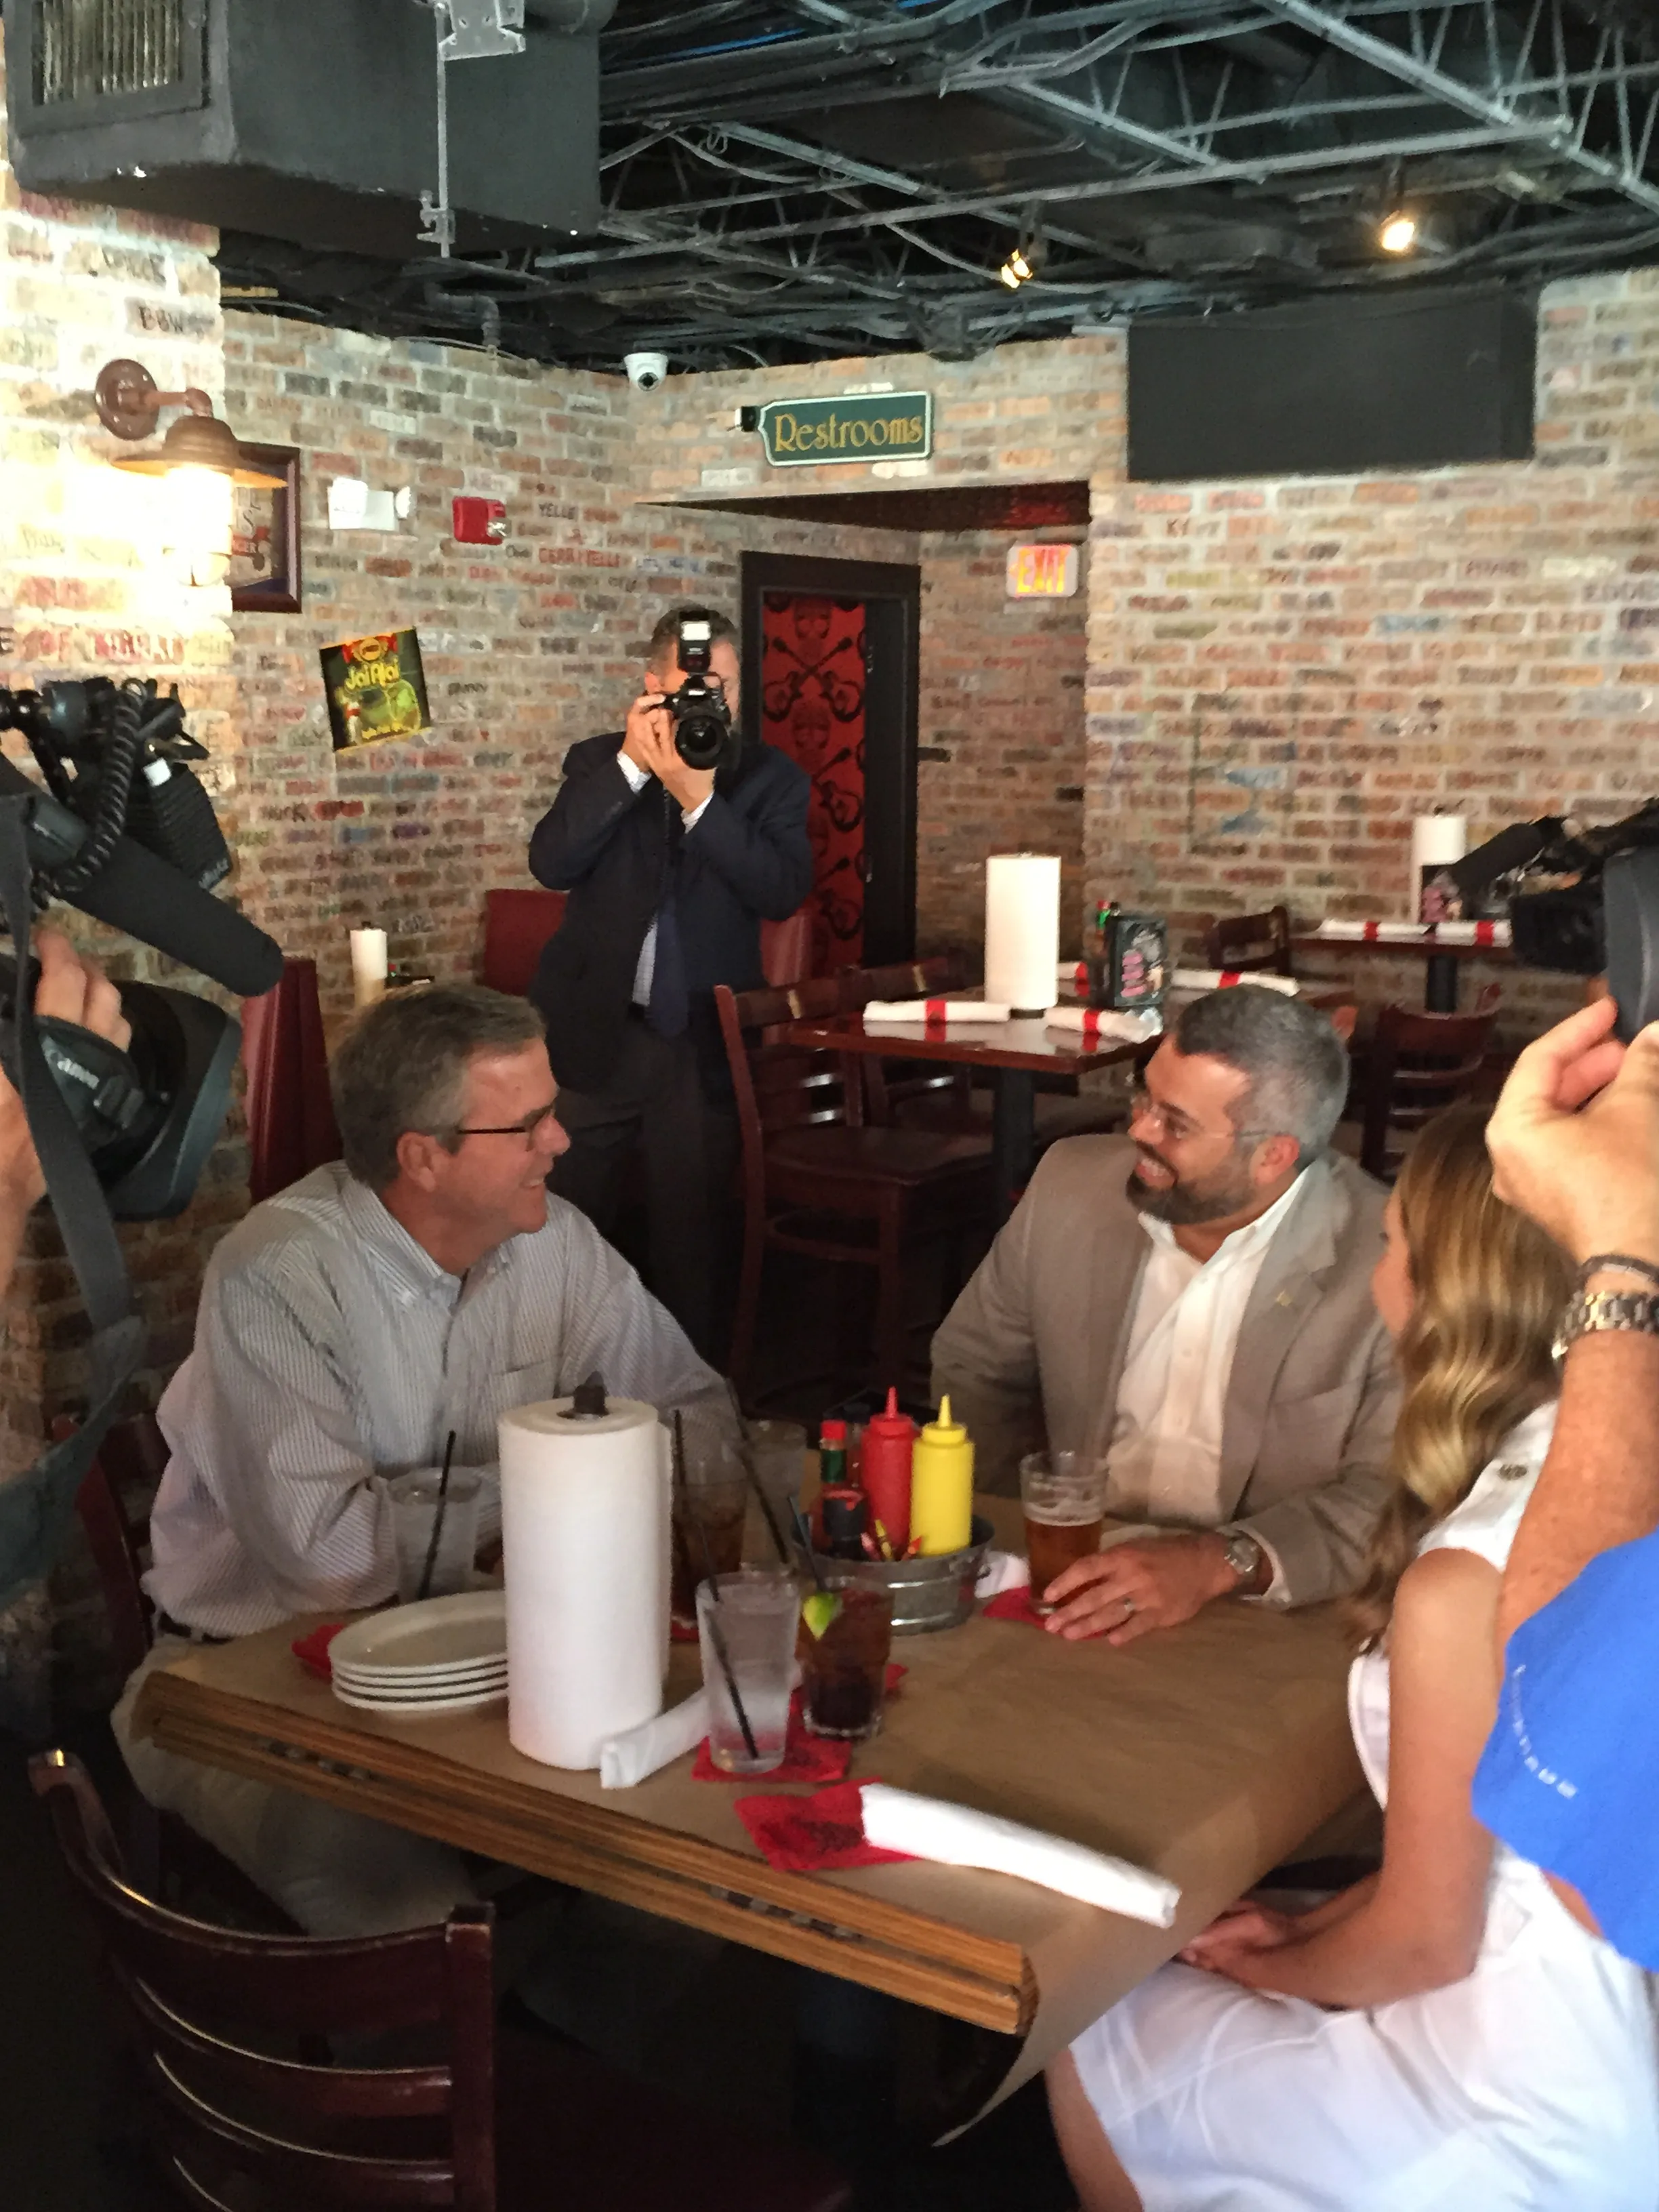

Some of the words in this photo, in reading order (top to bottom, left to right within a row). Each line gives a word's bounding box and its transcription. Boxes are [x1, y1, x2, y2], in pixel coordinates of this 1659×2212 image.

[774, 412, 924, 453] Restrooms
[1016, 546, 1070, 594] EXIT
[344, 662, 371, 690] Jai
